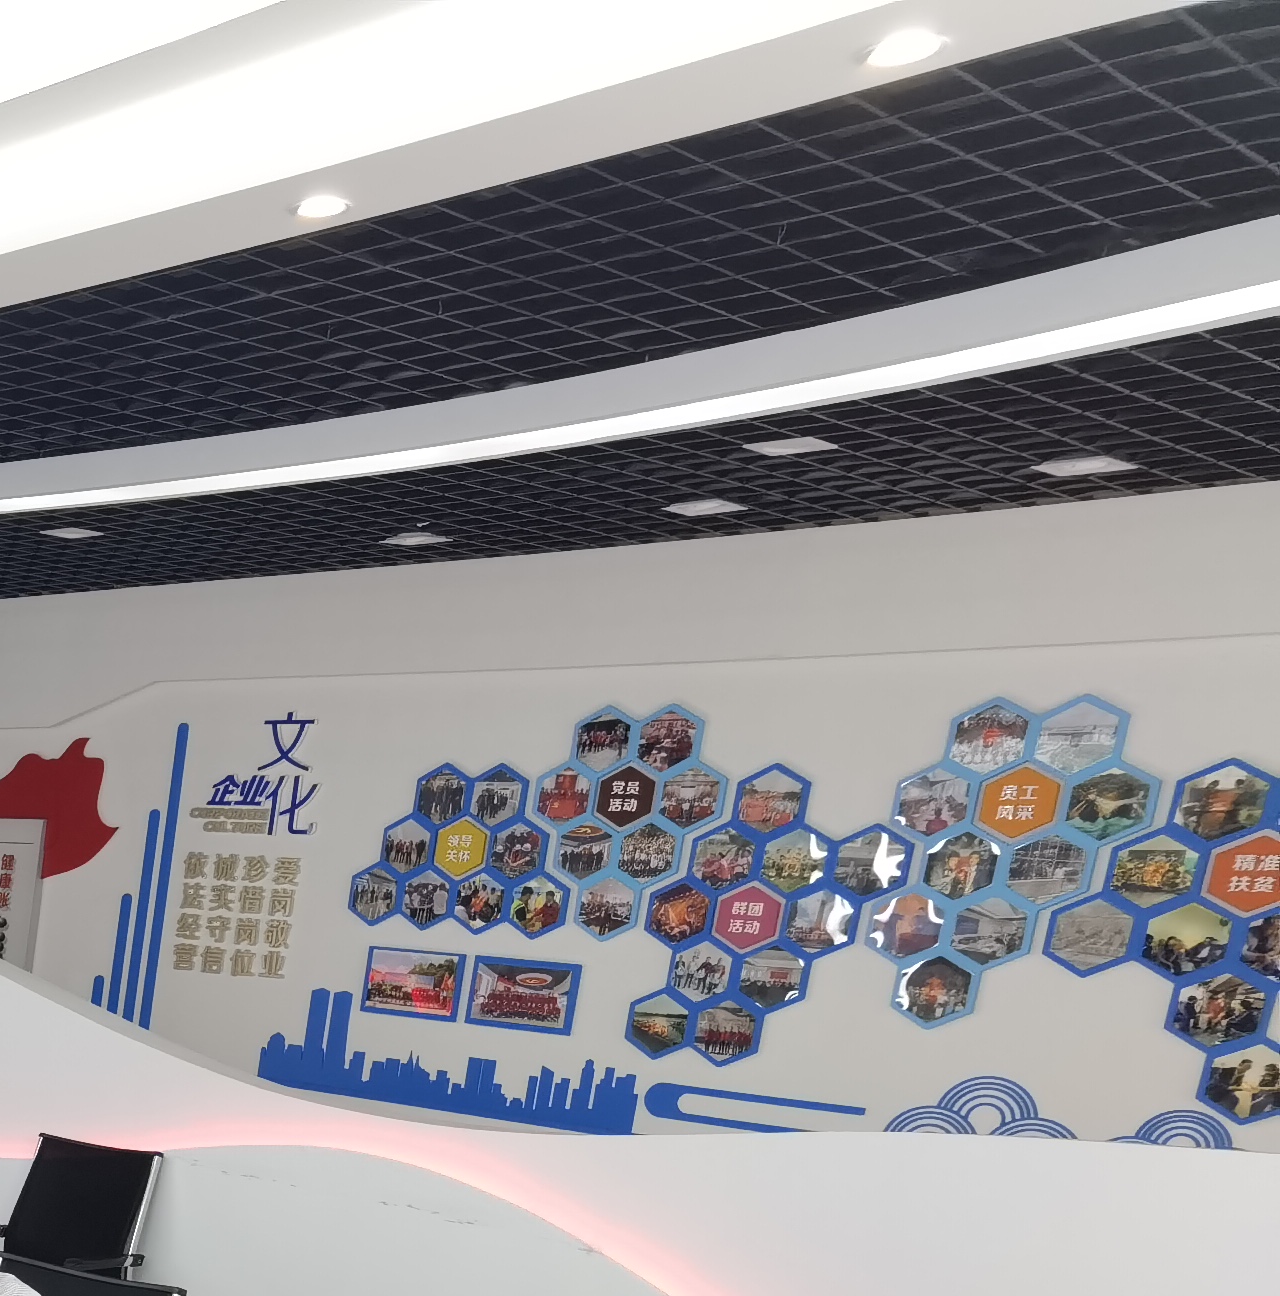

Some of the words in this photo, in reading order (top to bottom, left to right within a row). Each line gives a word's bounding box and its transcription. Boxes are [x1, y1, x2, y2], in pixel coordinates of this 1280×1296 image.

[610, 781, 640, 796] 党员
[999, 784, 1039, 802] 员工
[608, 797, 638, 813] 活动
[995, 804, 1035, 821] 风采
[446, 834, 474, 849] 领导
[444, 848, 471, 864] 关怀
[1233, 853, 1280, 872] 精准
[1228, 876, 1279, 895] 扶贫
[731, 900, 764, 917] 群团
[728, 919, 760, 935] 活动
